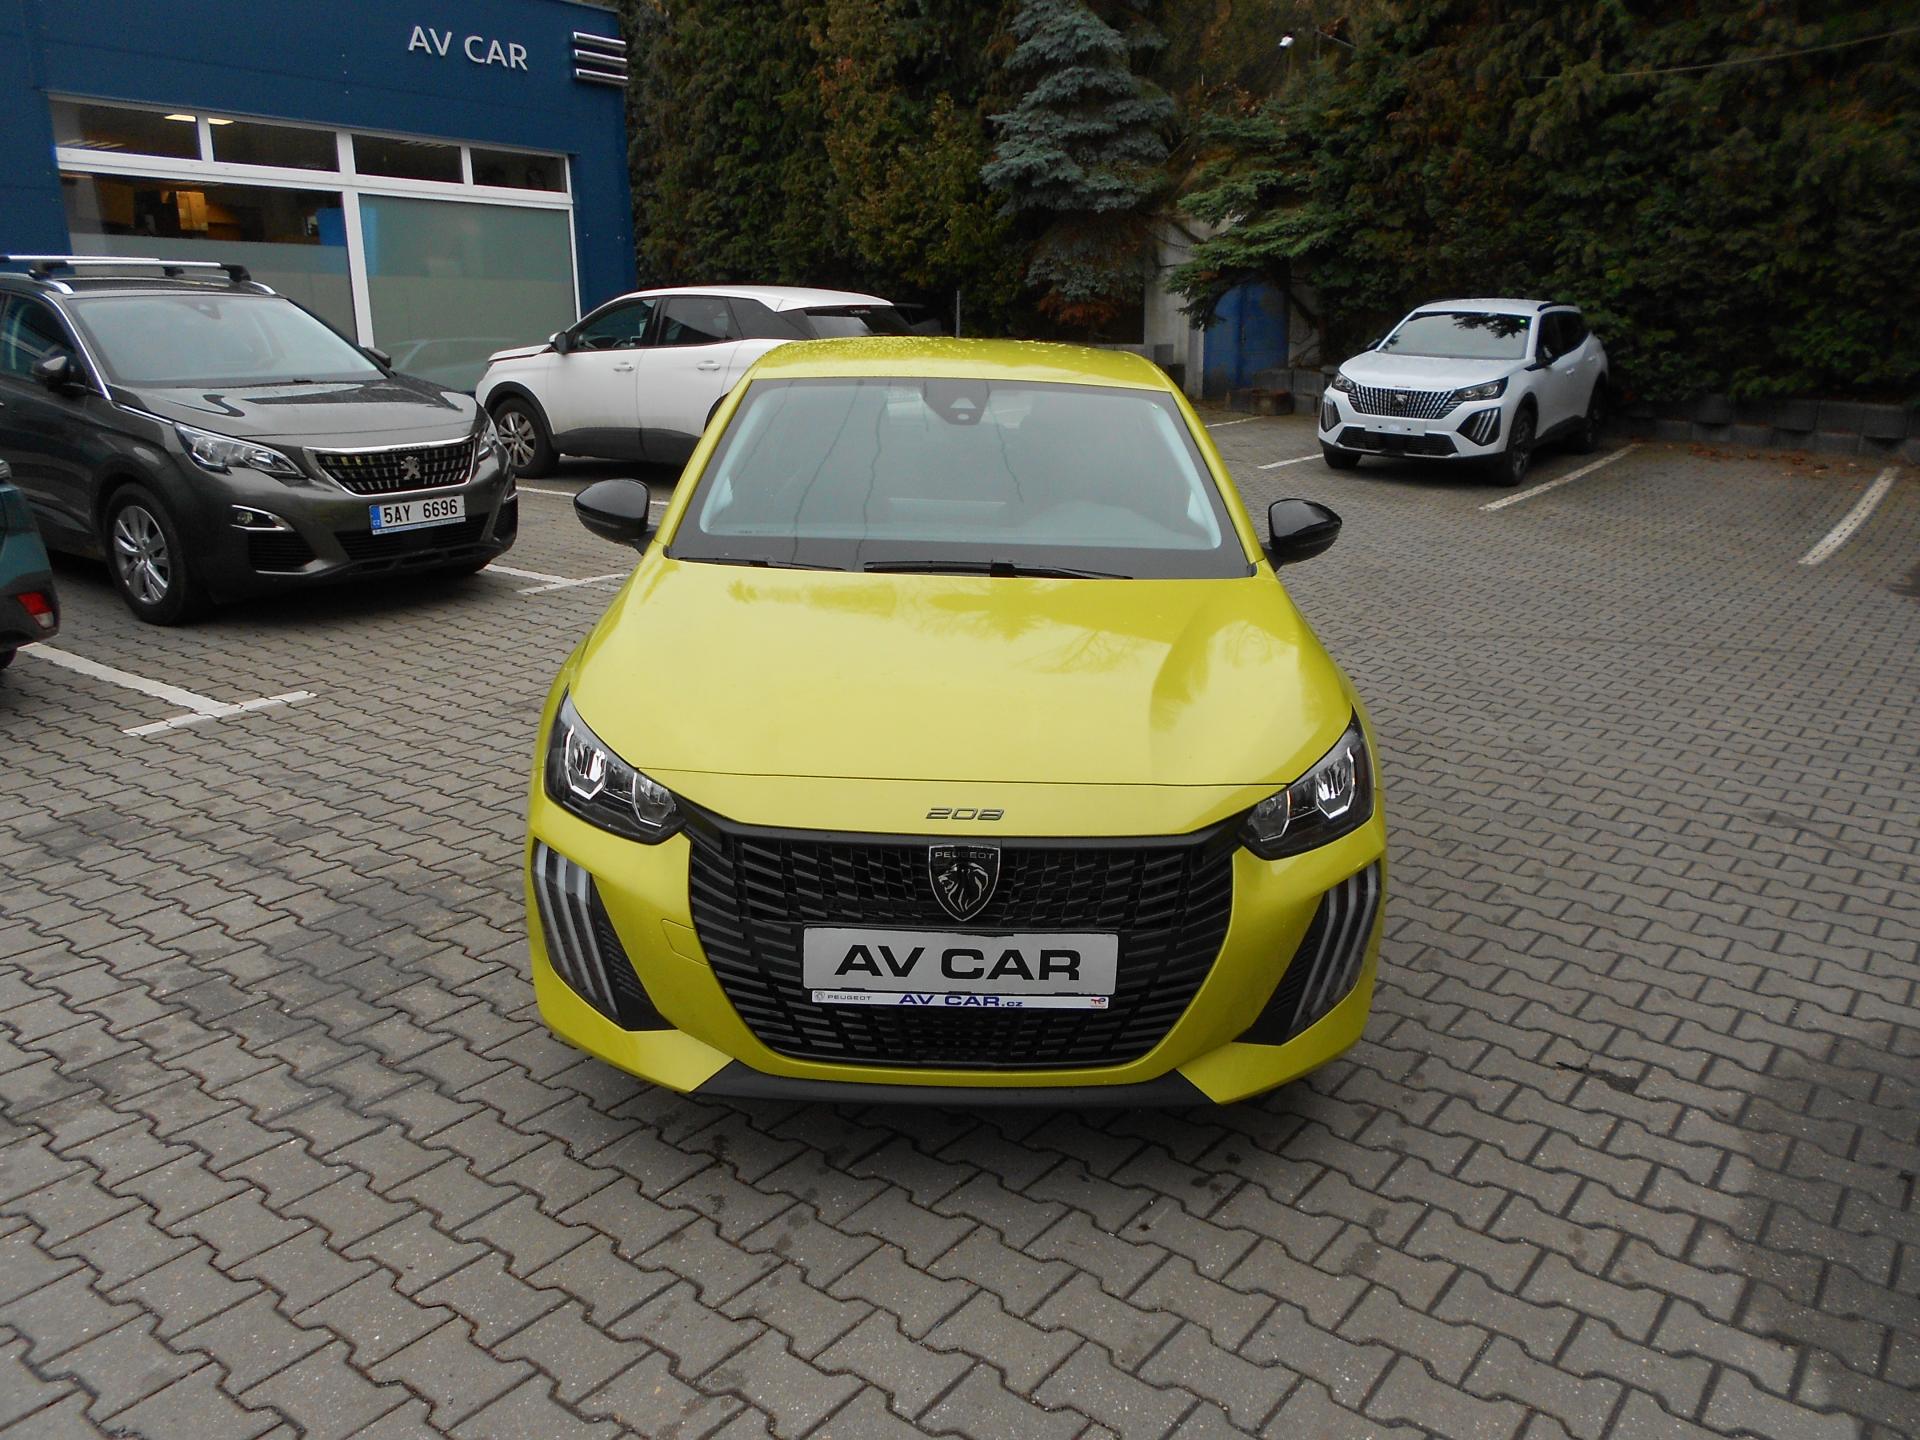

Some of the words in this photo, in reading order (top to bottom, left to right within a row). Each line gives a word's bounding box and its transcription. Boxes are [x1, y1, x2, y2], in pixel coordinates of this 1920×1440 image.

[408, 25, 452, 57] AV
[464, 35, 528, 71] CAR
[384, 505, 410, 523] 5AY
[423, 499, 457, 518] 6696
[926, 808, 1005, 821] 208
[934, 851, 995, 860] PEUEOT
[834, 944, 926, 977] AV
[940, 948, 1081, 981] CAR
[899, 993, 935, 1005] AV
[944, 994, 1023, 1008] CAR.cz
